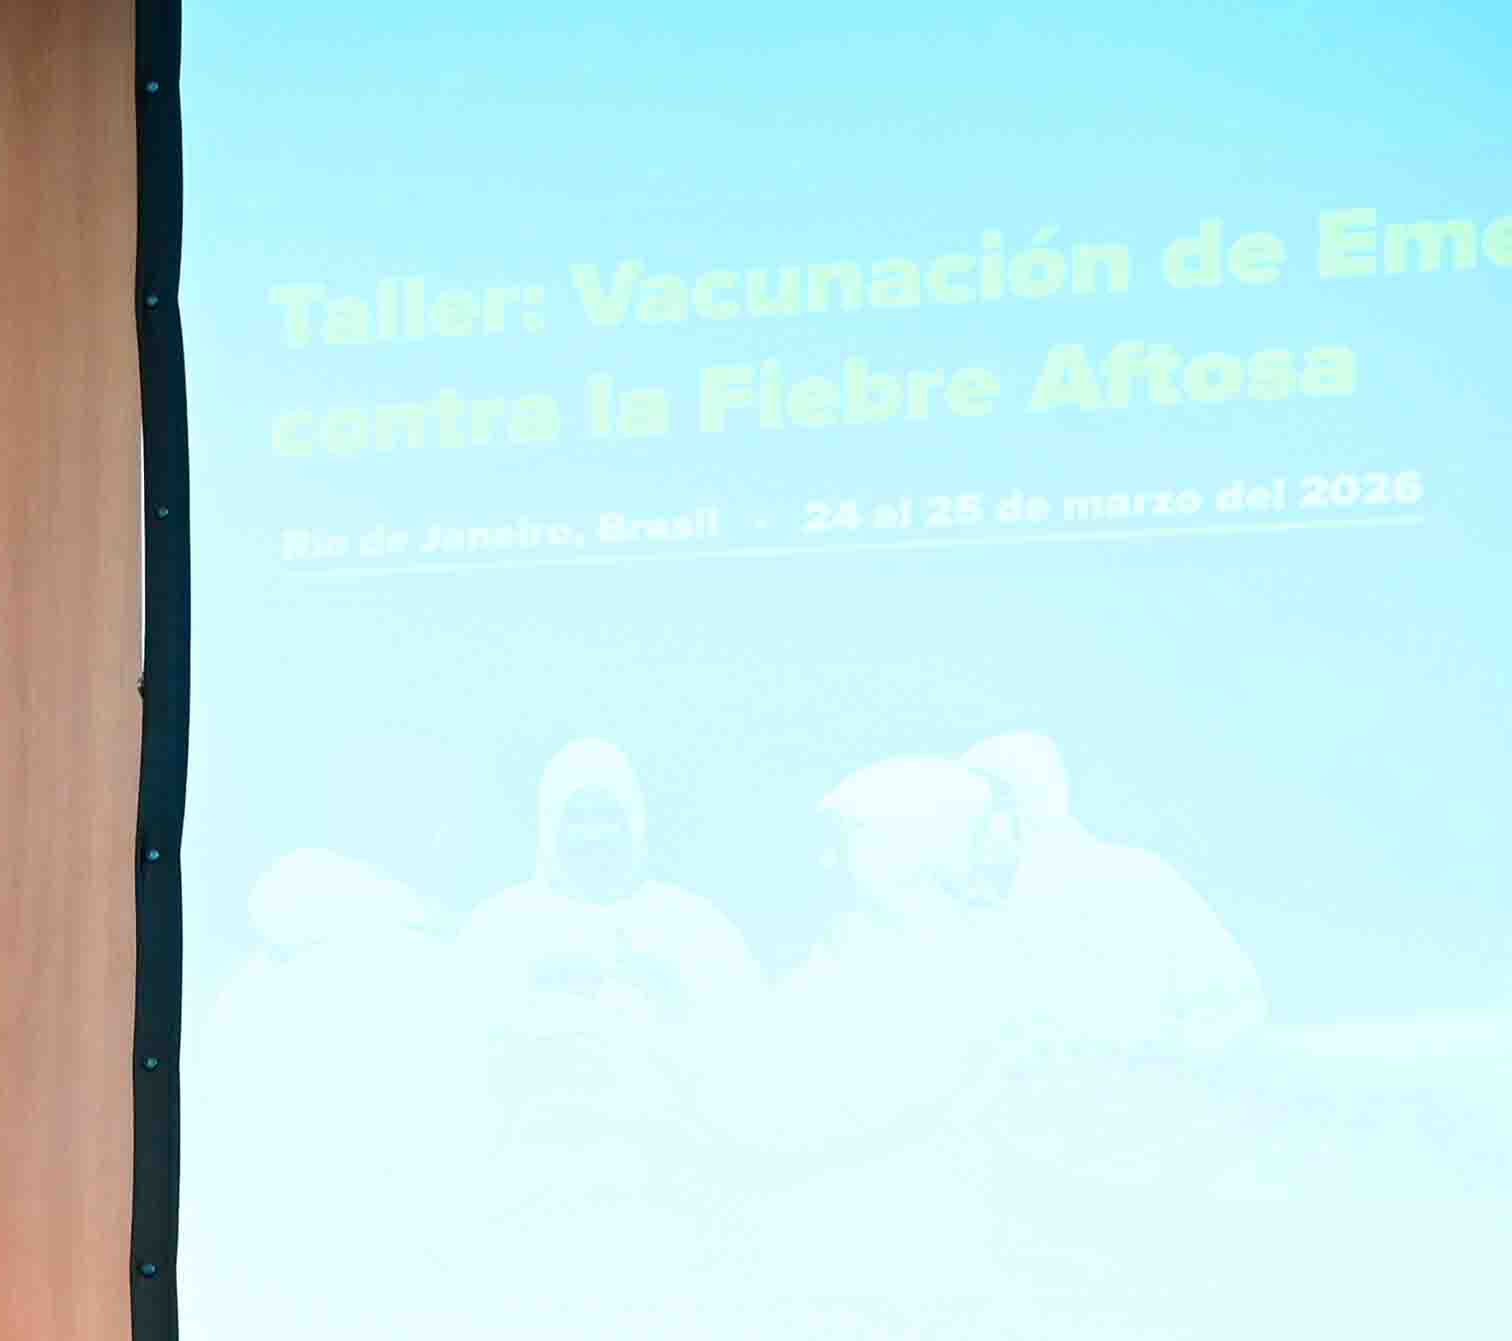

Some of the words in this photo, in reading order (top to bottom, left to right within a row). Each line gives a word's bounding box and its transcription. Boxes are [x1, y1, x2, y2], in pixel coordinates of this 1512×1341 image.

[266, 275, 548, 349] Taller:
[570, 225, 1131, 329] Vacunación
[1165, 216, 1285, 290] de
[267, 386, 561, 460] contra
[584, 371, 671, 440] la
[697, 353, 1003, 435] Fiebre
[1024, 339, 1356, 414] Aftosa
[804, 494, 862, 536] 24
[924, 489, 985, 528] 25
[999, 485, 1052, 525] de
[1063, 484, 1203, 523] marzo
[1215, 477, 1286, 515] del
[1298, 468, 1427, 509] 2026
